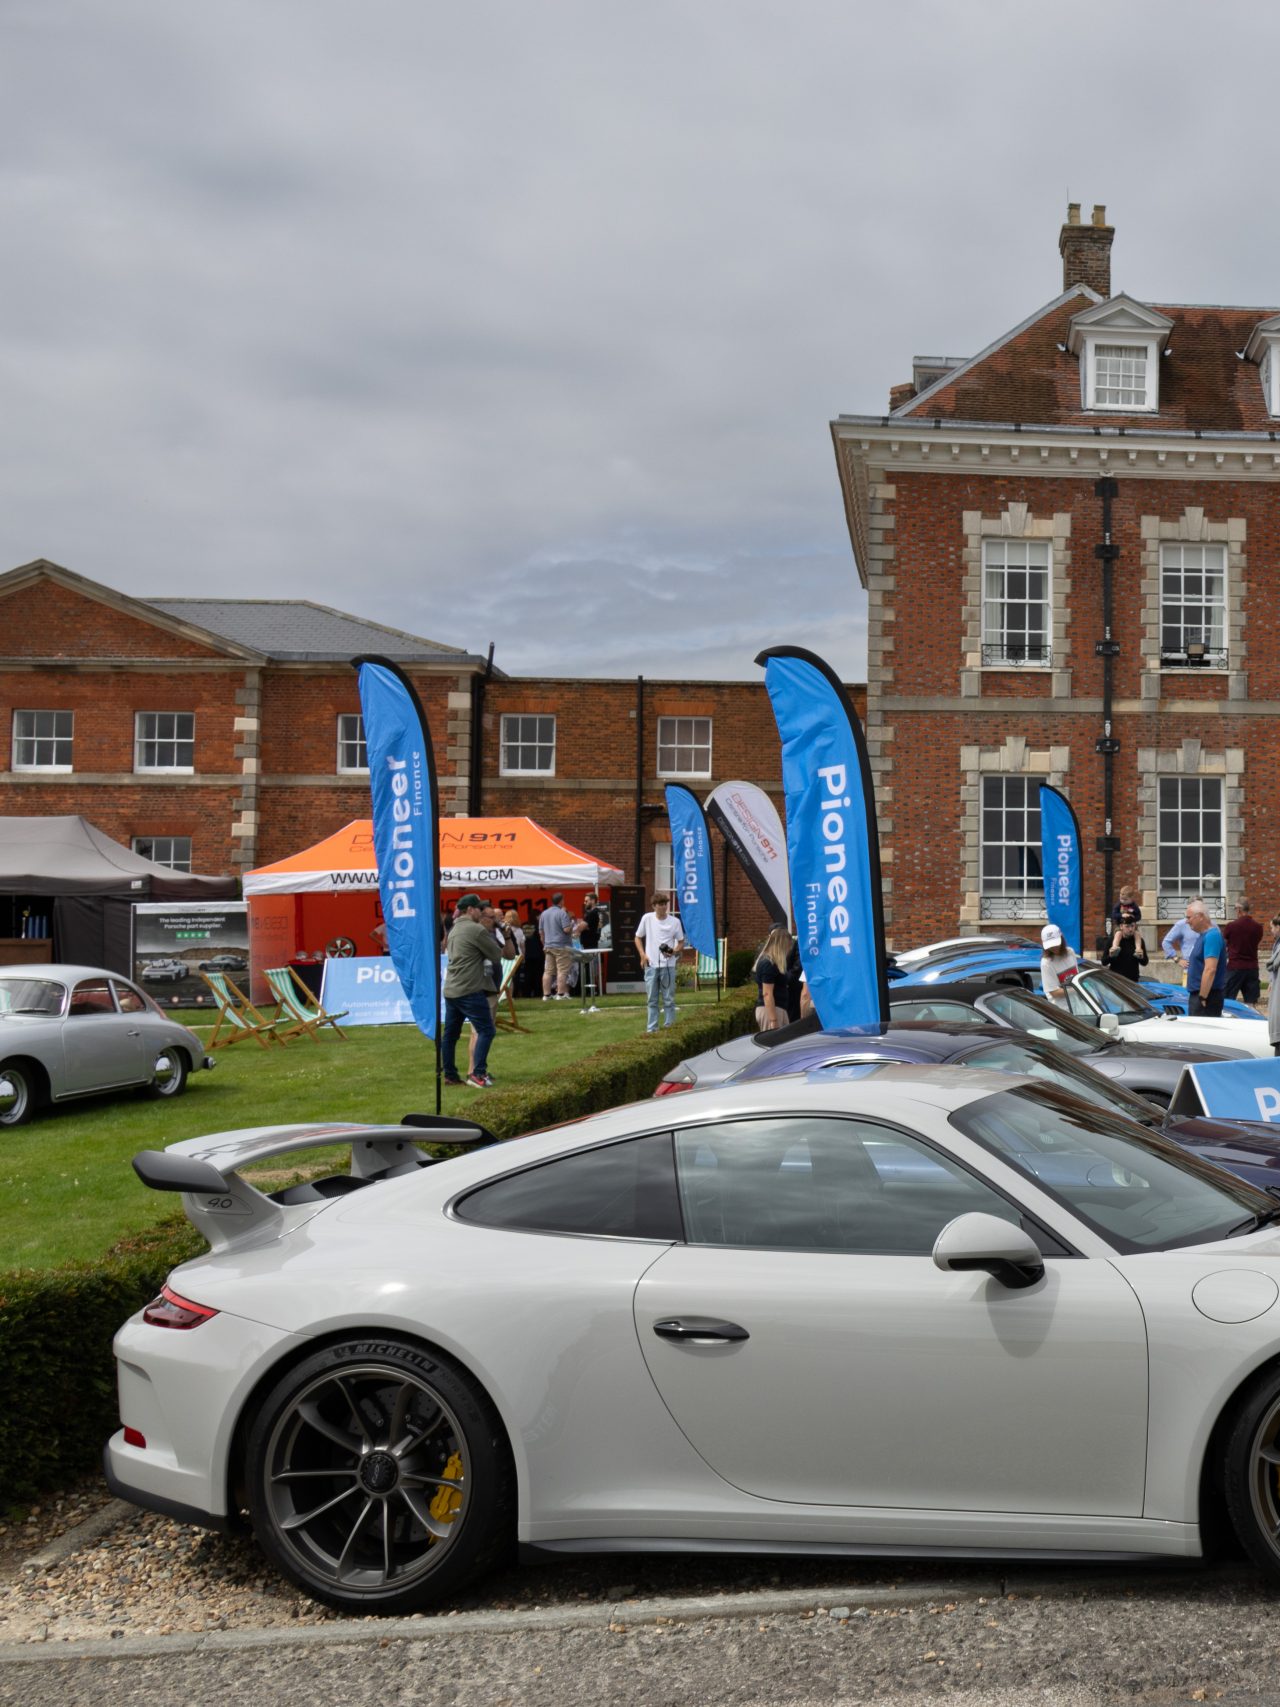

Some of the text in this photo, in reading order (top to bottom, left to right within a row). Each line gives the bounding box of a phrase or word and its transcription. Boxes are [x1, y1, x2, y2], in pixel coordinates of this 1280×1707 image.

[412, 751, 423, 816] Finance
[386, 755, 417, 918] Pioneer
[682, 828, 698, 904] Pioneer
[818, 764, 851, 955] Pioneer
[1057, 834, 1073, 906] Pioneer
[805, 882, 821, 956] Finance
[208, 1198, 233, 1209] 4.0
[355, 1344, 434, 1371] MICHELIN
